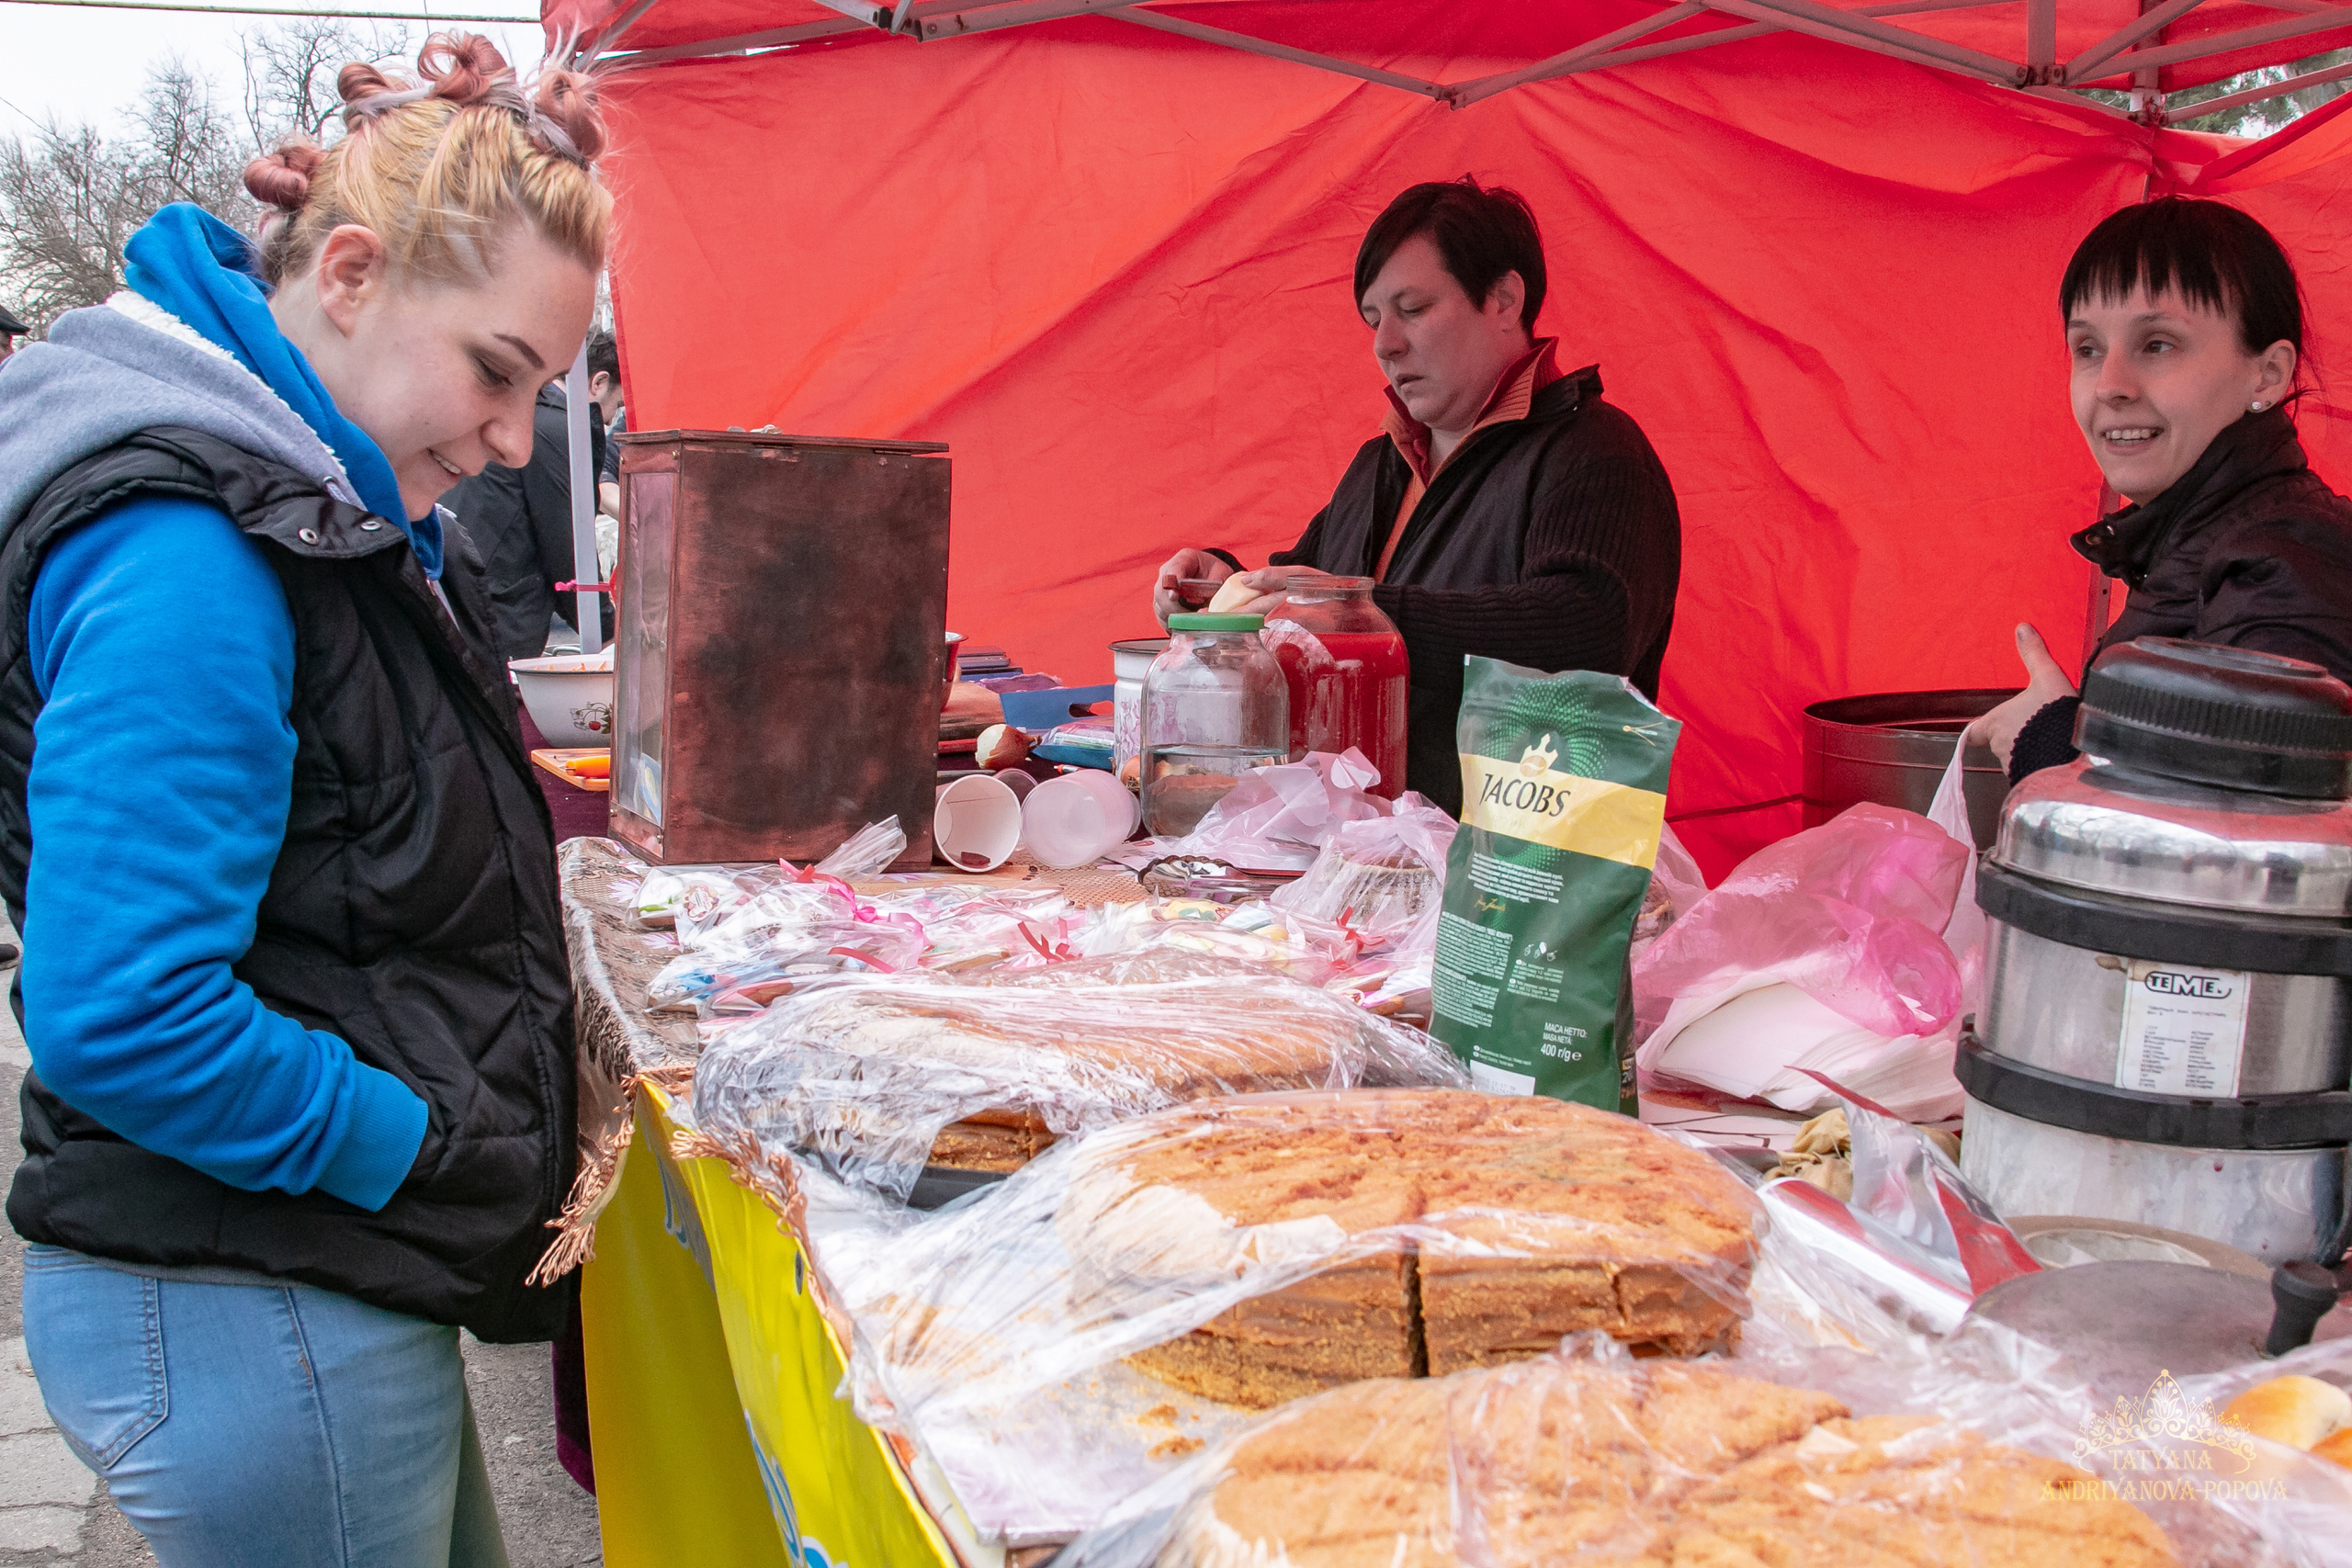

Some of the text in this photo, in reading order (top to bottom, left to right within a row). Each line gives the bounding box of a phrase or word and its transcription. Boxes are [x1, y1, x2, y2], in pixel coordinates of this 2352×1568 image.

[1479, 773, 1571, 818] JACOBS
[2149, 974, 2223, 997] TEME
[1544, 1021, 1563, 1033] МАСА
[1540, 1043, 1556, 1057] 400
